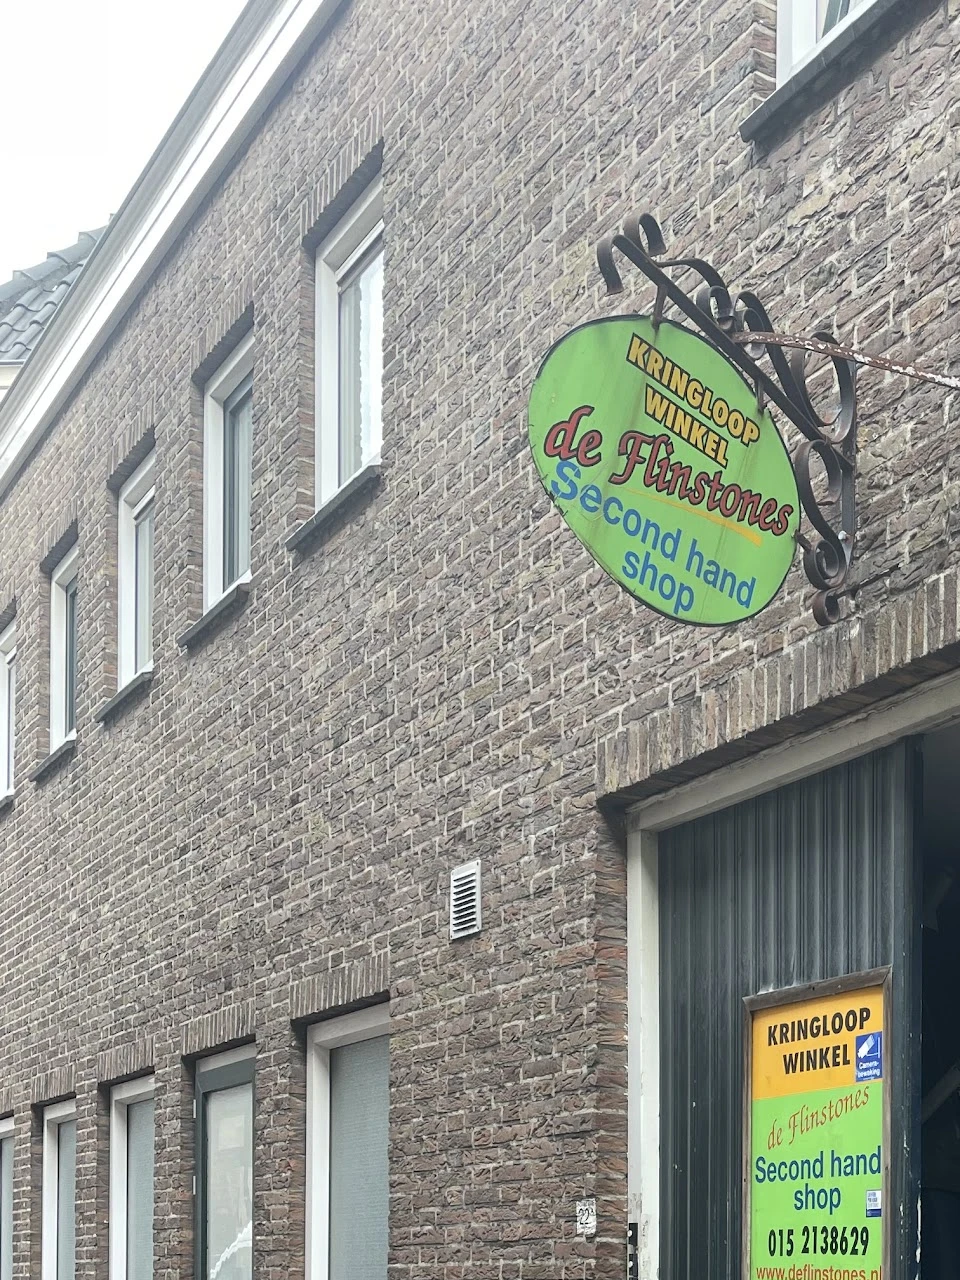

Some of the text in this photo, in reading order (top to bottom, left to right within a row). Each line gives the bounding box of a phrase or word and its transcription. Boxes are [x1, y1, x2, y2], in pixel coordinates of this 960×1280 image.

[626, 333, 760, 447] KRINGLOOP
[645, 384, 728, 468] WINKEL
[544, 405, 793, 536] de Flinstones
[551, 460, 756, 609] Second hand
[622, 551, 694, 614] shop
[767, 1007, 871, 1046] KRINGLOOP
[783, 1044, 850, 1075] WINKEL
[767, 1086, 870, 1150] de Flinstones
[755, 1146, 882, 1183] Second hand
[793, 1183, 841, 1215] shop
[768, 1226, 869, 1257] 015 2138629
